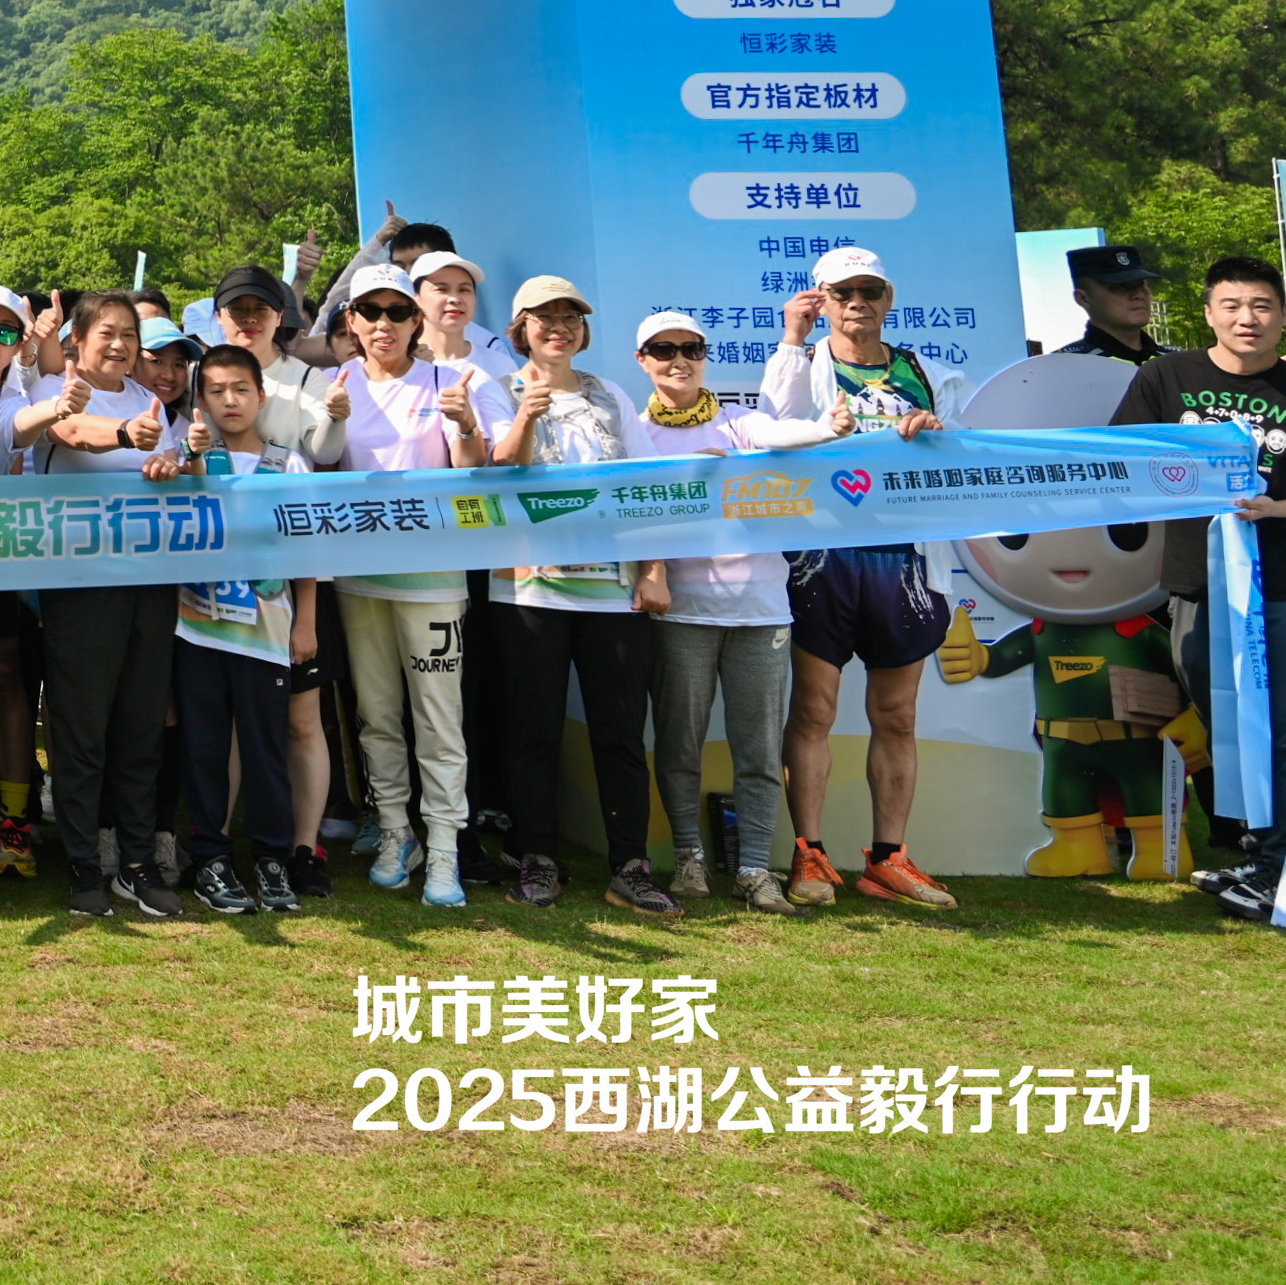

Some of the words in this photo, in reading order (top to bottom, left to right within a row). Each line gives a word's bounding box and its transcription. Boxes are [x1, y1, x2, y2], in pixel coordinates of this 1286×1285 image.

[740, 32, 838, 55] 恒彩家装
[706, 82, 880, 110] 官方指定板材
[737, 131, 860, 155] 千年舟集团
[745, 182, 862, 210] 支持单位
[1180, 390, 1286, 424] BOSTON
[882, 461, 1130, 491] 未来婚姻家庭咨询服务中心
[611, 481, 708, 504] 千年舟集团
[721, 477, 814, 501] FM107
[886, 495, 918, 504] FUTURE
[920, 494, 960, 502] MARRIAGE
[981, 491, 1009, 499] FAMILY
[1011, 489, 1062, 498] COUNSELING
[1064, 487, 1098, 496] SERVICE
[1100, 485, 1131, 495] CENTER
[527, 497, 585, 509] Treezo
[615, 507, 664, 519] TREEZO
[669, 503, 711, 515] GROUP
[728, 500, 808, 516] 浙江城市之声
[273, 498, 431, 537] 恒彩家装
[1054, 661, 1094, 671] Treezo
